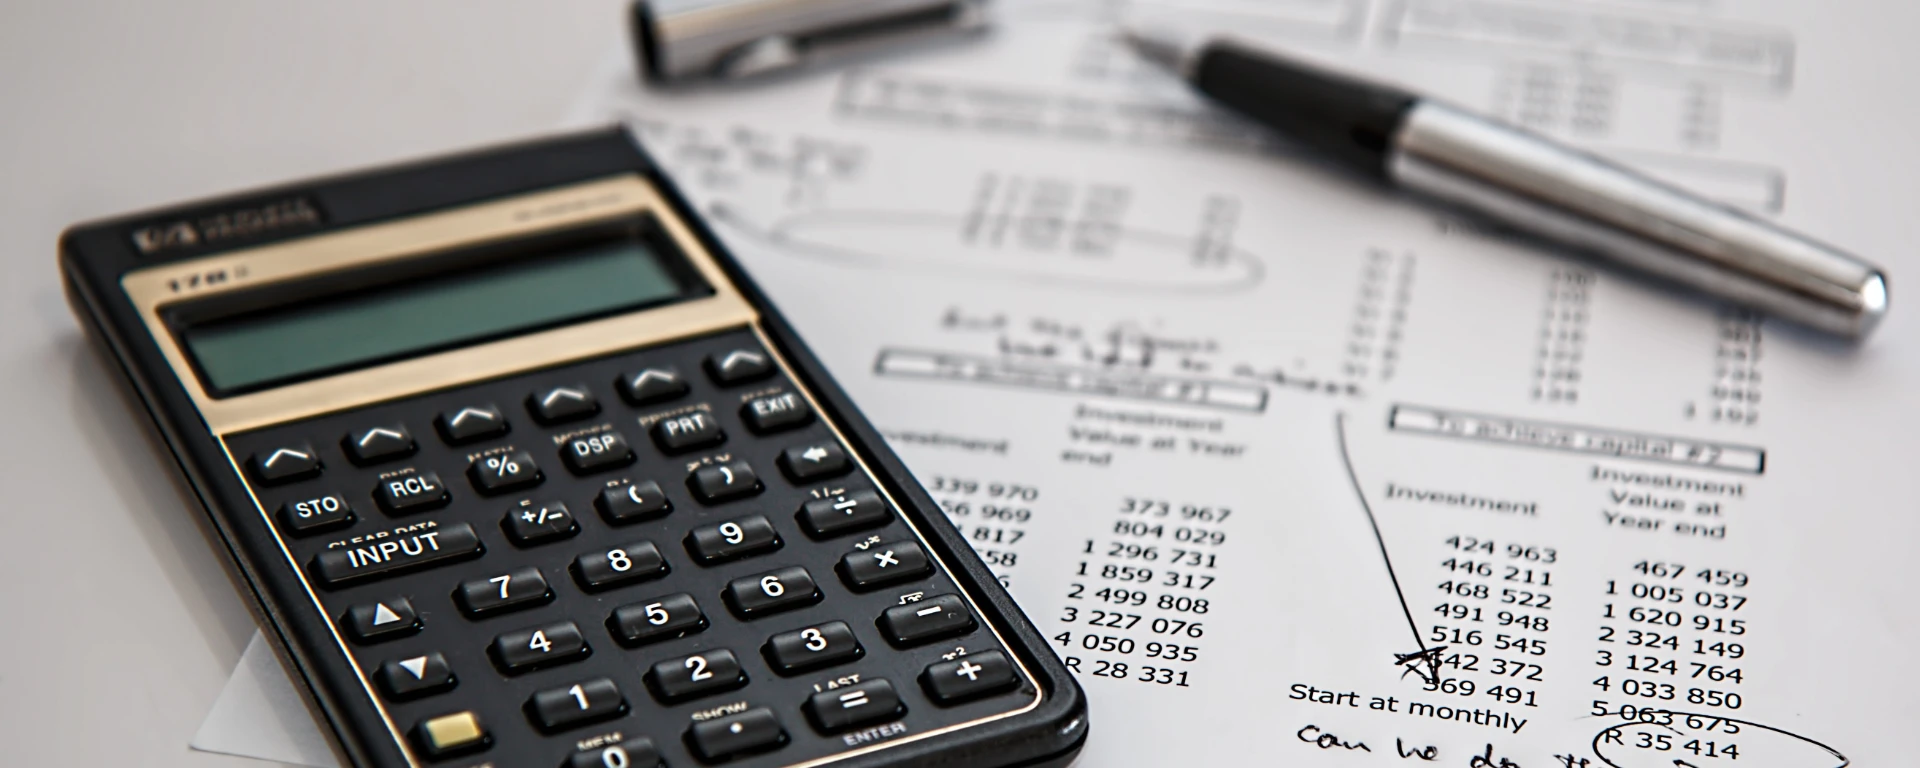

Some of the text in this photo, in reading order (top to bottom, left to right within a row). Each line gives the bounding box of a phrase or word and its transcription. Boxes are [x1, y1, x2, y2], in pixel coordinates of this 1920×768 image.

[753, 394, 797, 417] EXIT
[665, 413, 706, 437] PRT
[573, 433, 615, 457] DSP
[880, 428, 1008, 455] vestment
[1069, 427, 1140, 448] Value
[1150, 436, 1175, 451] at
[486, 455, 520, 477] %
[1061, 449, 1112, 467] end
[389, 475, 435, 498] RCL
[931, 477, 1038, 502] 339 970
[1591, 466, 1743, 497] Investment
[295, 495, 340, 519] STO
[1120, 497, 1231, 524] 373 967
[1385, 483, 1539, 517] Investment
[1611, 488, 1722, 516] Value at
[982, 505, 1032, 523] 969
[1603, 510, 1726, 540] Year end
[718, 521, 744, 545] 9
[973, 527, 1025, 545] 817
[1113, 521, 1226, 546] 804 029
[347, 531, 439, 568] INPUT
[606, 548, 633, 573] 8
[1084, 539, 1218, 569] 1 296 731
[1445, 535, 1557, 563] 424 963
[1077, 562, 1216, 590] 1 859 317
[1441, 557, 1552, 586] 446 211
[1634, 560, 1749, 588] 467 459
[489, 573, 512, 600] 7
[759, 575, 785, 599] 6
[1068, 583, 1210, 614] 2 499 808
[1438, 580, 1552, 609] 468 522
[1605, 580, 1748, 611] 1 005 037
[644, 602, 670, 626] 5
[1060, 606, 1205, 638] 3 227 076
[1434, 602, 1550, 632] 491 948
[1603, 604, 1746, 636] 1 620 915
[528, 629, 553, 653] 4
[800, 627, 828, 652] 3
[1054, 631, 1199, 662] 4 050 935
[1430, 625, 1547, 656] 516 545
[1598, 626, 1745, 659] 2 324 149
[684, 655, 713, 682] 2
[1065, 656, 1191, 687] R 28 331
[1490, 658, 1543, 681] 372
[1595, 650, 1744, 684] 3 124 764
[568, 683, 590, 711] 1
[1486, 685, 1539, 707] 491
[1592, 676, 1742, 710] 4 033 850
[1288, 683, 1528, 734] Start at monthly
[1591, 700, 1741, 735] 5 063 675
[842, 721, 908, 747] ENTER
[1604, 728, 1740, 760] R 35 414
[602, 745, 629, 768] 0
